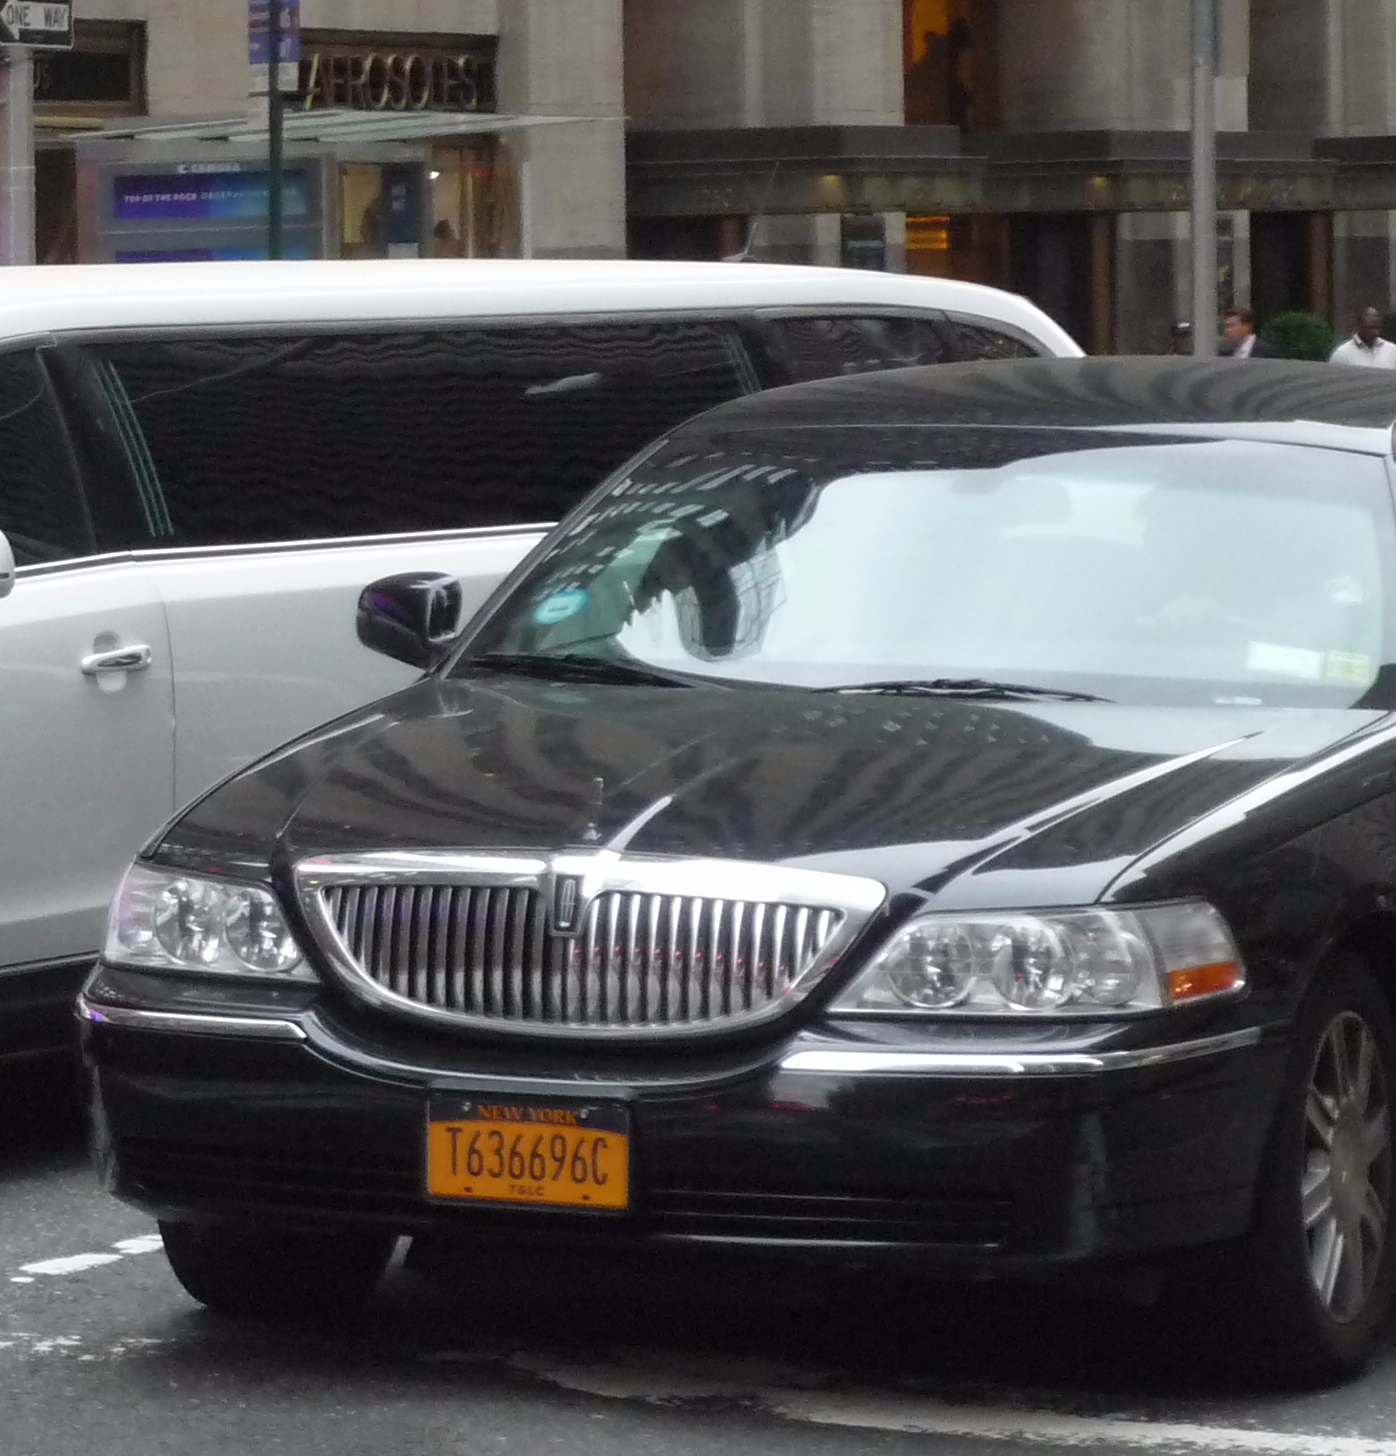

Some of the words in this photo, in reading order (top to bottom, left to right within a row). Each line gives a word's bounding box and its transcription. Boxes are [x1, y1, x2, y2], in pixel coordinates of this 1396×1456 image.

[6, 4, 30, 26] ONE
[43, 7, 68, 28] WAY
[303, 52, 478, 111] AEROSOLES
[478, 1105, 523, 1121] NEW
[528, 1107, 580, 1127] YORK
[445, 1126, 609, 1187] T636696C
